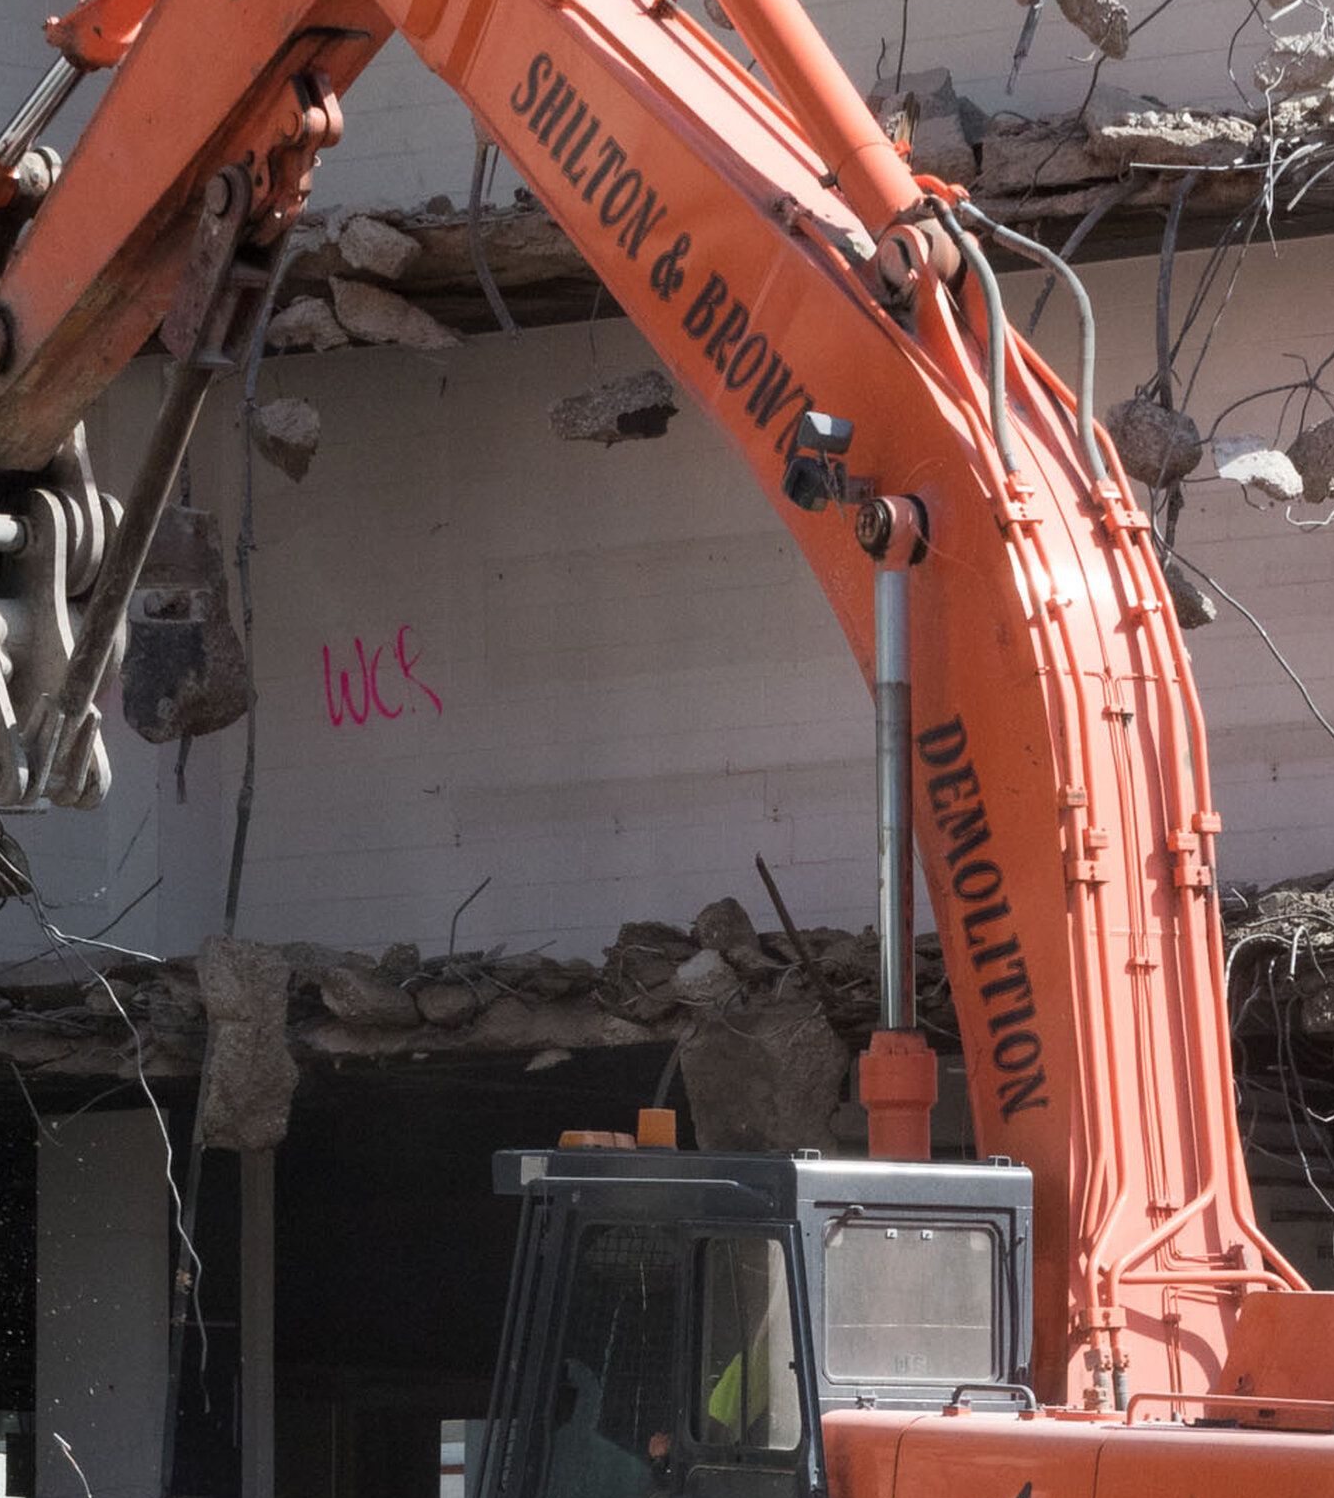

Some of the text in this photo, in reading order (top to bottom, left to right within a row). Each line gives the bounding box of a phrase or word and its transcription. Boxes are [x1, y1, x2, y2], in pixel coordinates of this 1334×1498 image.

[509, 51, 816, 466] SHILTON & BROWN
[917, 712, 1050, 1124] DEMOLITION
